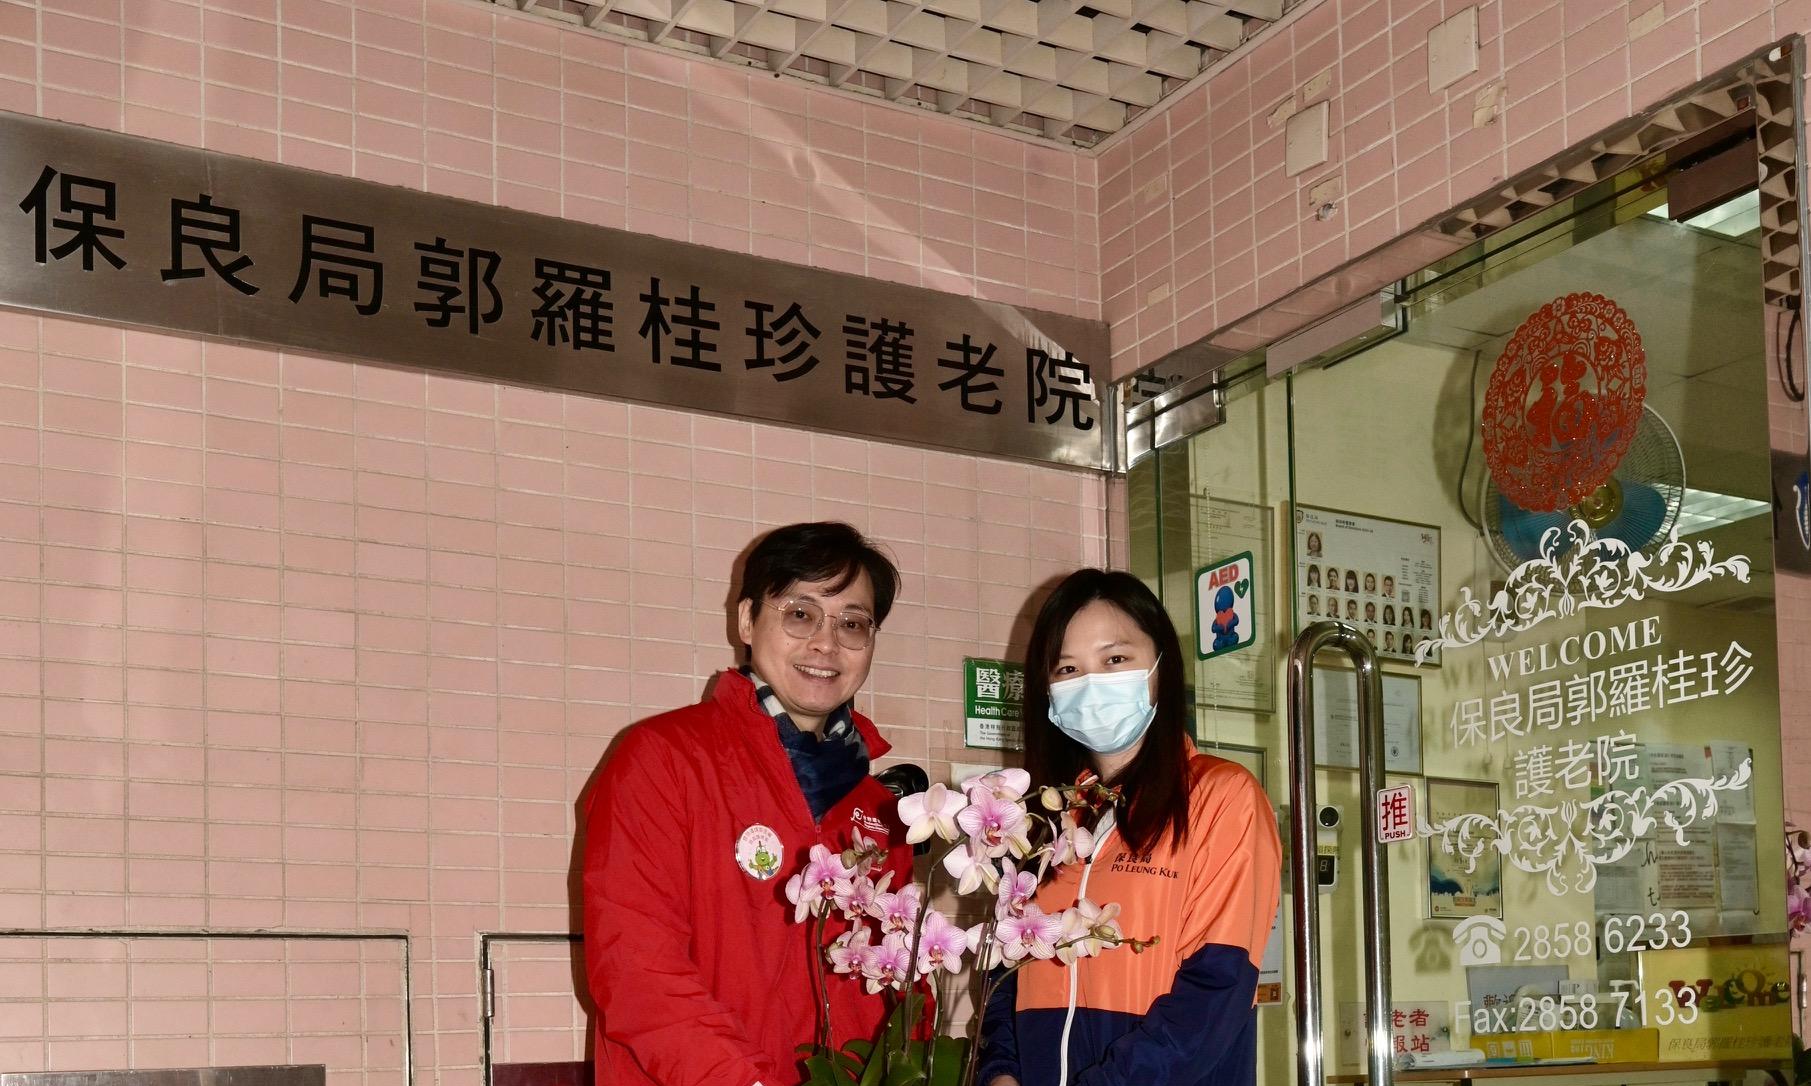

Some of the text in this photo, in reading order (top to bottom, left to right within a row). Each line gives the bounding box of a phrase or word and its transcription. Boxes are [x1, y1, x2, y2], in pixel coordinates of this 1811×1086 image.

[19, 164, 1095, 432] 保良局郭羅桂珍護老院
[1208, 563, 1240, 591] AED
[1487, 615, 1663, 683] WELCOME
[975, 705, 1001, 717] Health
[1450, 640, 1754, 749] 保良局郭羅桂珍
[1513, 729, 1640, 800] 護老院
[1382, 792, 1409, 832] 推
[1384, 830, 1406, 840] PUSH
[1110, 863, 1124, 872] PO
[1125, 863, 1157, 875] LEUNG
[1513, 909, 1693, 961] 2858 6233
[1609, 986, 1699, 1029] 7133
